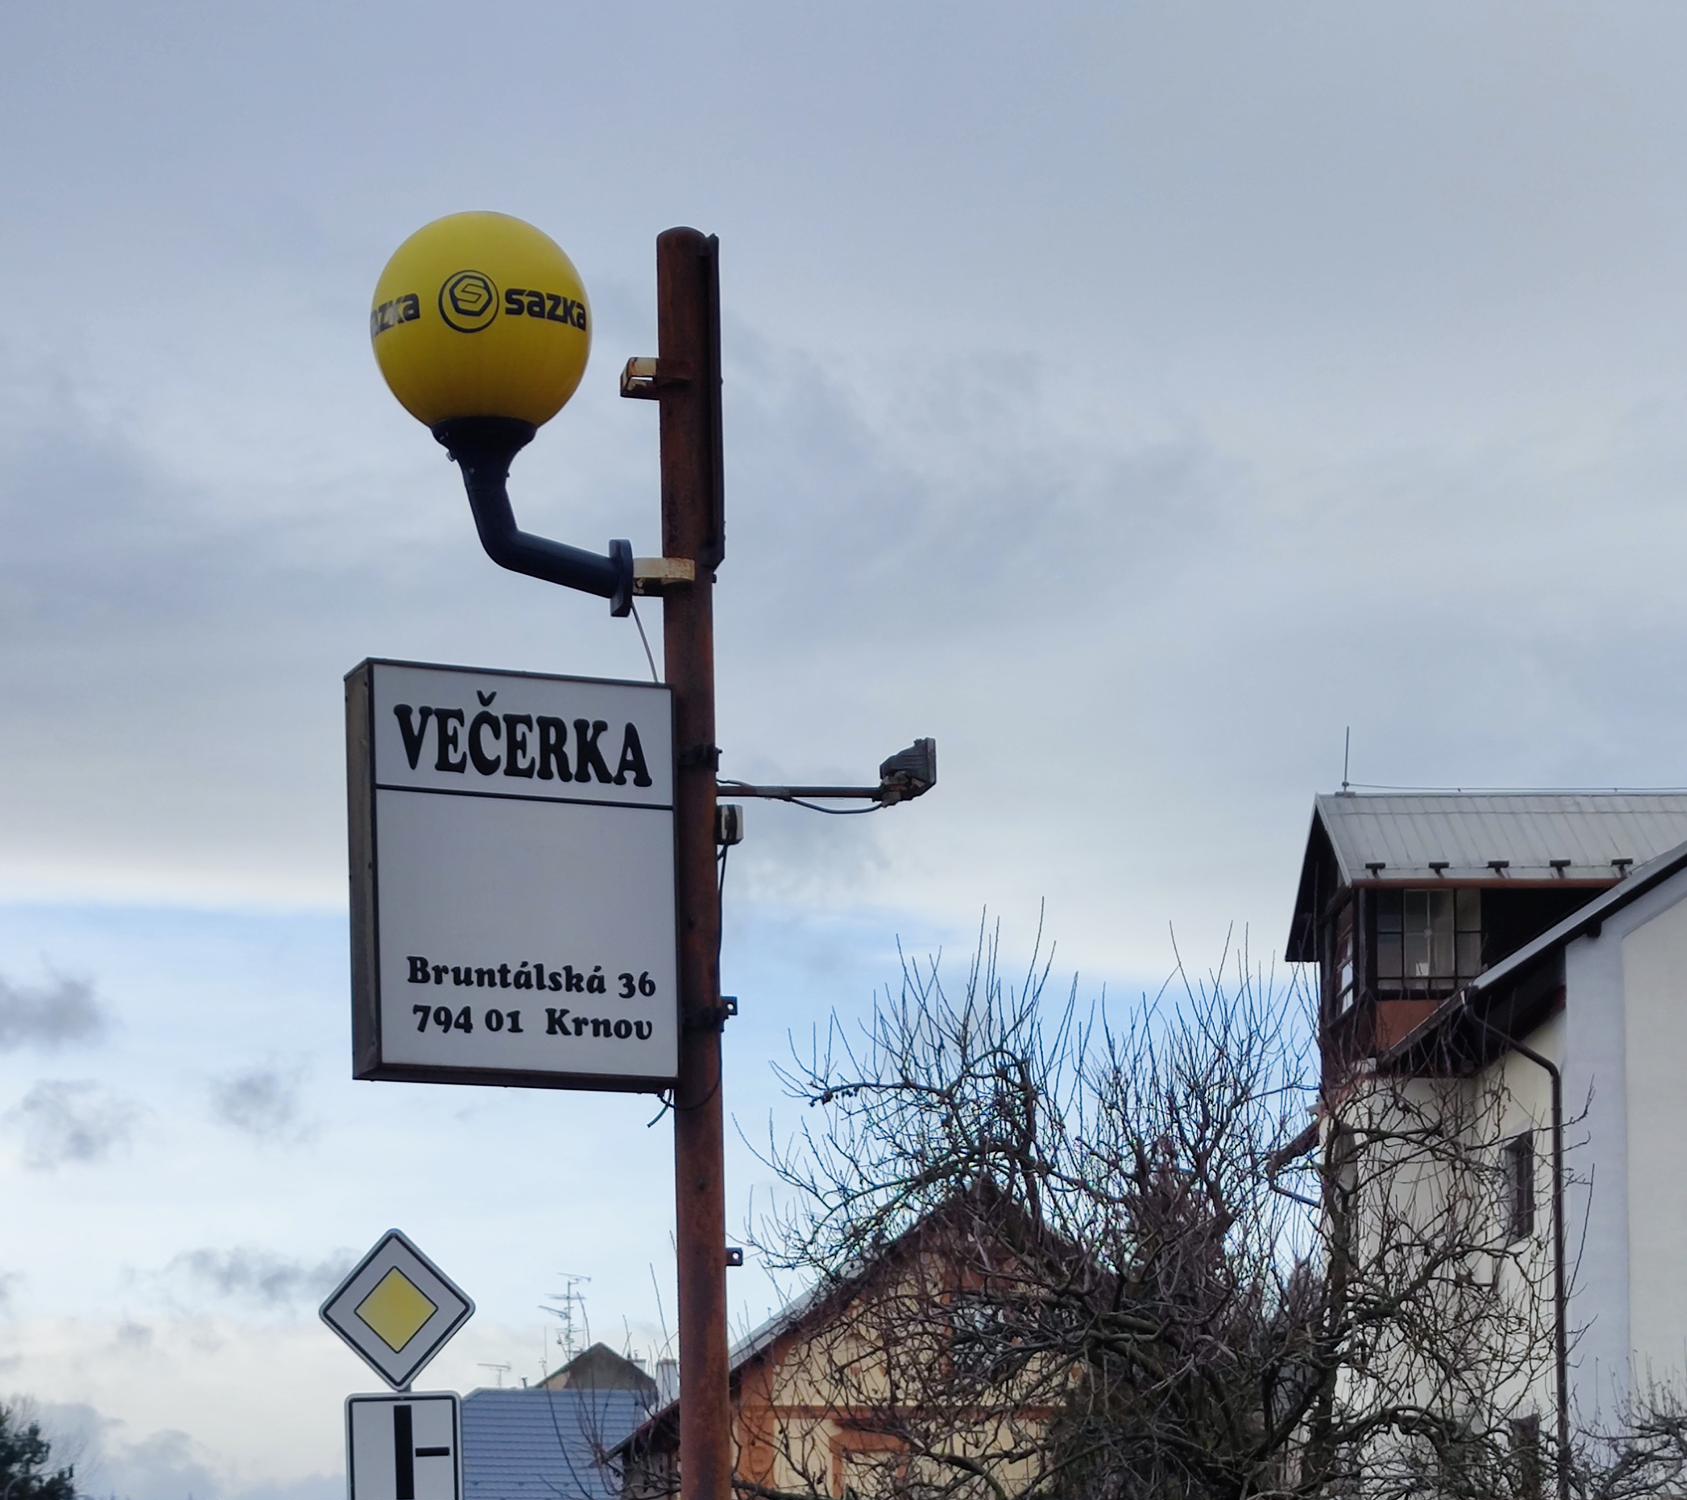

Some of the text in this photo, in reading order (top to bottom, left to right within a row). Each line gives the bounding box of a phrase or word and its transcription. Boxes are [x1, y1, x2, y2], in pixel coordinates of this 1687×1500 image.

[393, 689, 653, 787] VEČERKA
[406, 955, 657, 999] Bruntálská 36
[412, 1003, 653, 1040] 794 01 Krnov
